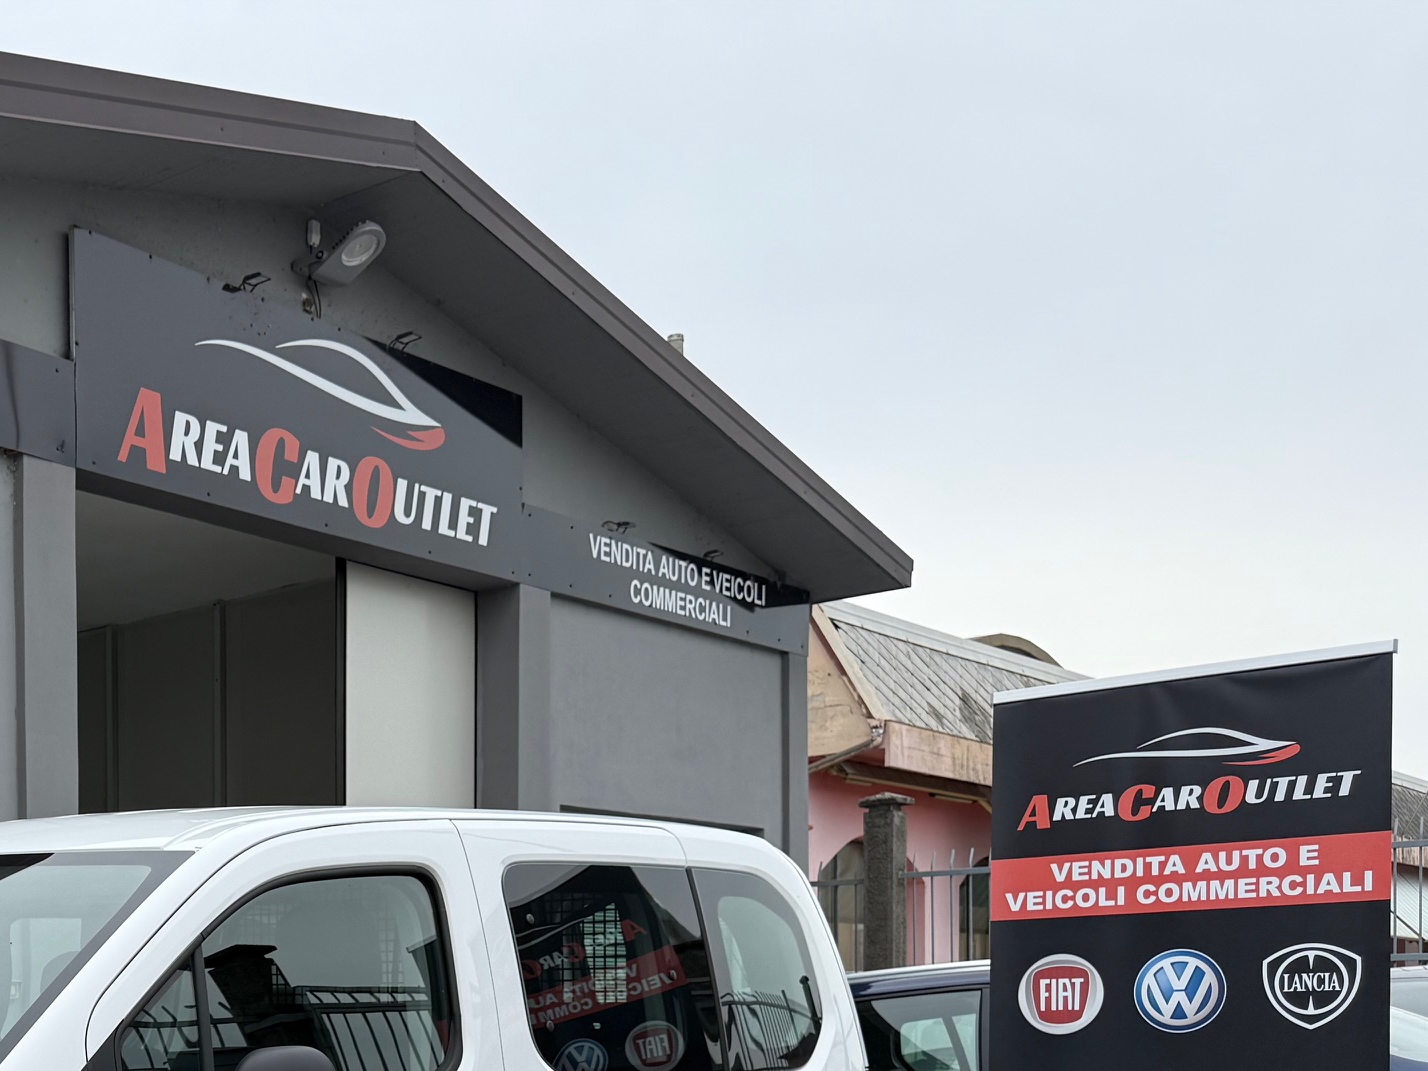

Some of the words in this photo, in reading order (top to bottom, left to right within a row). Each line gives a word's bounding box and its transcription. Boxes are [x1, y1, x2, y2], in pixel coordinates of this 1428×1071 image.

[589, 532, 656, 576] VENDITA
[658, 554, 699, 589] AUTO
[701, 566, 712, 589] E
[713, 568, 767, 607] VEICOLI
[629, 580, 732, 628] COMMERCIALI
[1050, 855, 1186, 883] VENDITA
[1195, 848, 1287, 873] AUTO
[1300, 844, 1320, 866] E
[1005, 886, 1125, 912] VEICOLI
[1136, 871, 1373, 904] COMMERCIALI
[1039, 977, 1084, 1012] FIAT
[1283, 972, 1341, 993] LANCIA
